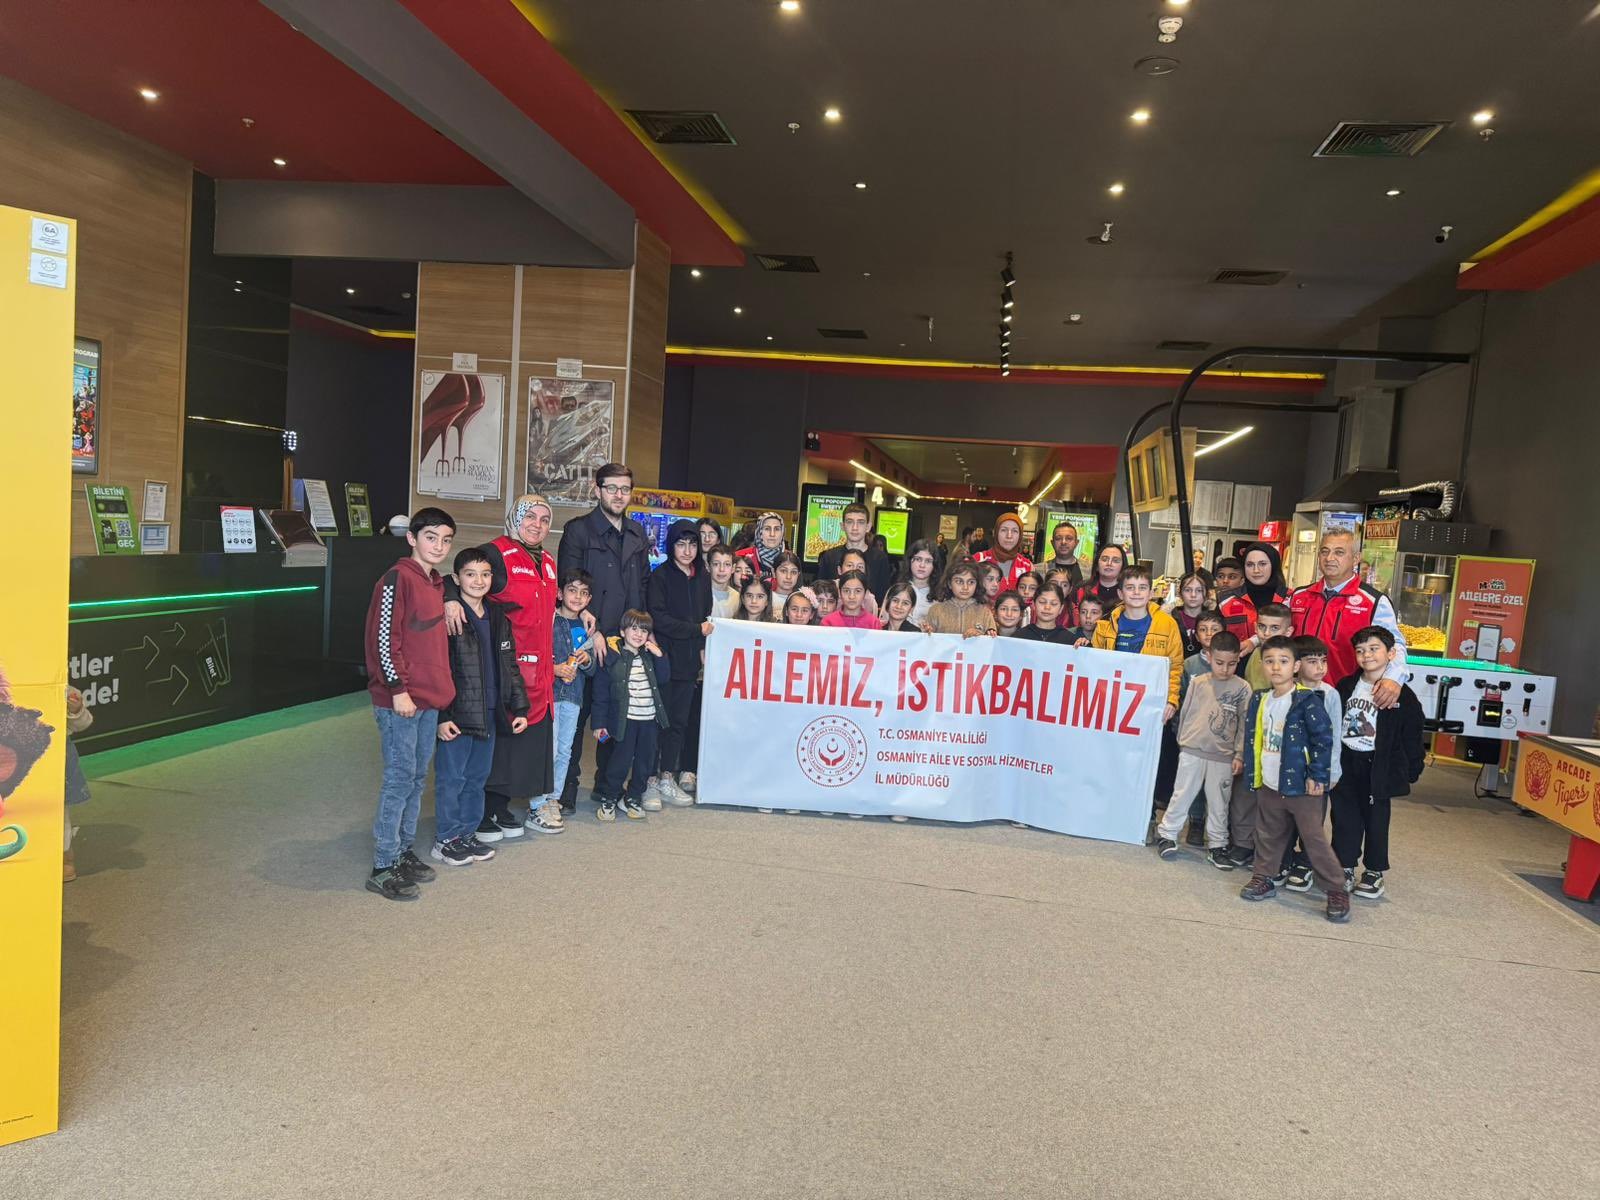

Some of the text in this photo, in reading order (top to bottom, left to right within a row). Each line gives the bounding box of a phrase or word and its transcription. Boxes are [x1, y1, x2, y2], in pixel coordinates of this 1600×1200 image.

[92, 486, 125, 496] BİLETİNİ
[872, 486, 884, 505] 4
[1017, 503, 1030, 524] 2
[1366, 523, 1398, 537] POPCORN
[117, 538, 136, 549] GEÇ
[1459, 590, 1502, 604] AİLELERE
[1502, 593, 1524, 606] ÖZEL
[205, 656, 217, 679] Bilet
[723, 638, 1147, 737] AİLEMİZ, İSTİKBALİMİZ
[879, 728, 988, 744] T.C. OSMANİYE VALİLİĞİ
[876, 750, 1054, 775] OSMANİYE AİLE VE SOSYAL HİZMETLER
[1556, 759, 1591, 782] ARCADE
[875, 772, 950, 788] İL MÜDÜRLÜĞÜ
[1553, 779, 1590, 816] Tigers
